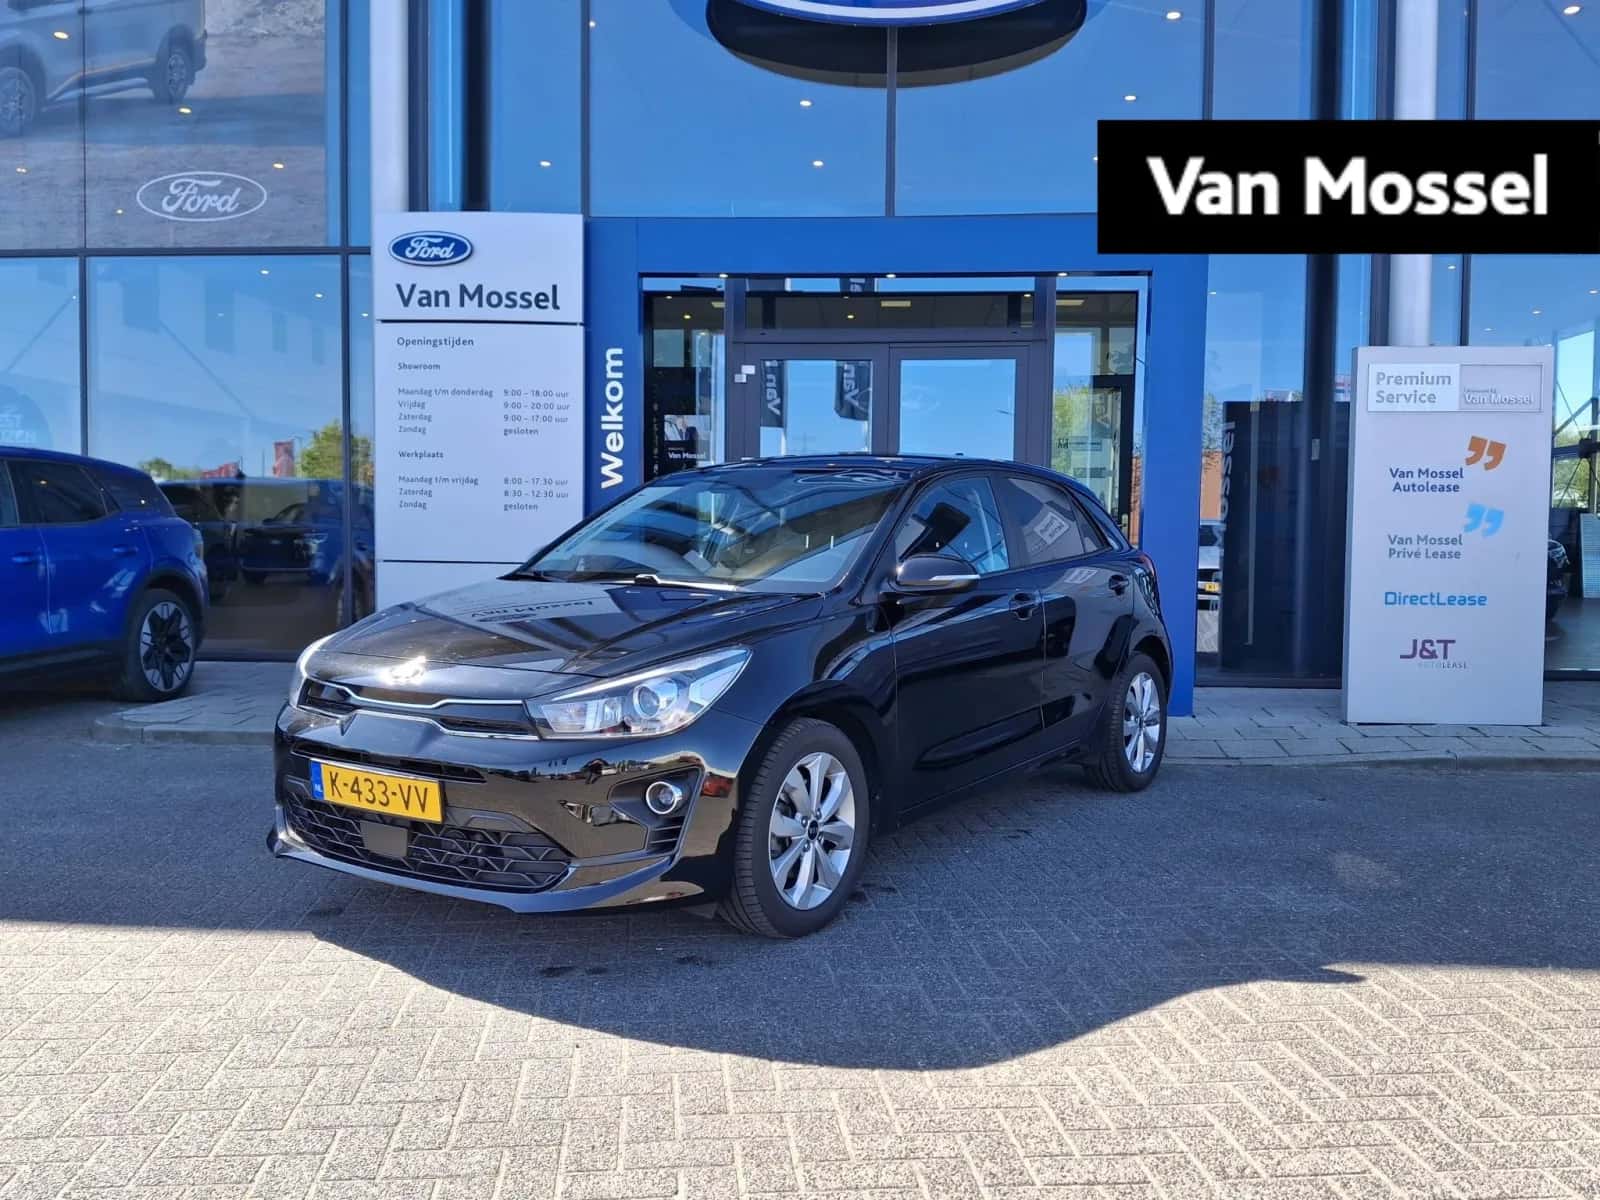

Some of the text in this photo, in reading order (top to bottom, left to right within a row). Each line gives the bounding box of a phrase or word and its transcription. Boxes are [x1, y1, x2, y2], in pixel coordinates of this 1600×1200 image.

[161, 178, 241, 213] Ford
[395, 283, 561, 310] Van Mossel
[396, 336, 475, 348] Openingstijden
[397, 361, 441, 371] Showroom
[1375, 371, 1452, 386] Premium
[398, 387, 432, 398] Maandag
[434, 388, 449, 397] t/m
[451, 387, 494, 399] donderdag
[555, 390, 569, 398] uur
[1375, 390, 1437, 404] Service
[398, 399, 426, 410] Vrijdag
[556, 403, 570, 411] uur
[1464, 393, 1534, 406] Van Mossel
[398, 412, 432, 423] Zaterdag
[600, 347, 624, 489] Welkom
[398, 425, 539, 437] Zondag gesloten
[398, 450, 444, 460] Werkplaats
[1389, 467, 1464, 479] Van Mossel
[398, 475, 433, 486] Maandag
[434, 475, 450, 485] t/m
[451, 475, 479, 487] vrijdag
[1392, 481, 1460, 493] Autolease
[399, 487, 433, 499] Zaterdag
[399, 500, 538, 512] Zondag gesloten
[1387, 534, 1463, 546] Van Mossel
[1388, 547, 1462, 560] Privé Lease
[1384, 591, 1488, 606] DirectLease
[1399, 638, 1456, 660] J&T
[328, 770, 429, 813] K-433-VV
